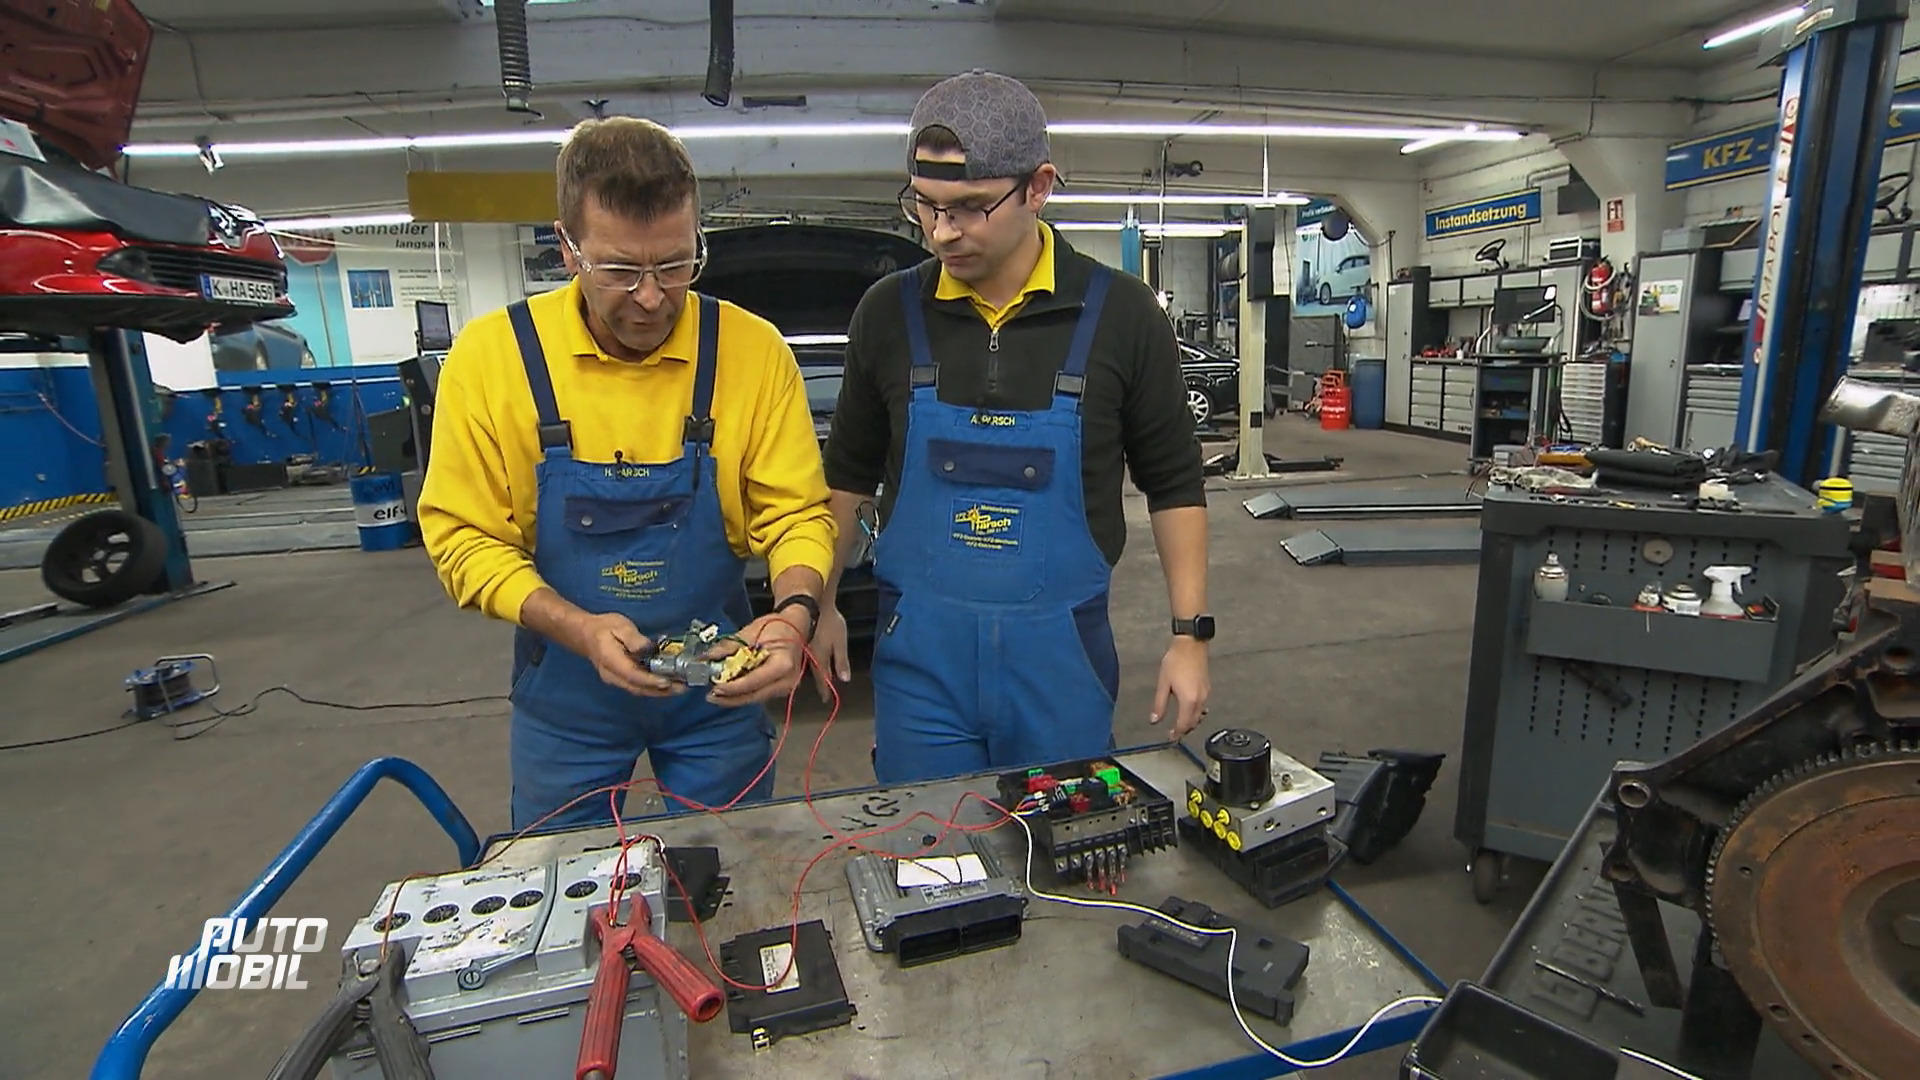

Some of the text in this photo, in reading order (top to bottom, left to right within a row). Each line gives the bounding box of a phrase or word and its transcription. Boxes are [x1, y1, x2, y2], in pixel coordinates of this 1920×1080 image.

[1703, 137, 1753, 170] KFZ
[1434, 202, 1527, 231] Instandsetzung
[211, 279, 223, 297] K
[229, 280, 248, 298] HA
[616, 467, 650, 478] ARSCH
[373, 506, 399, 520] elf
